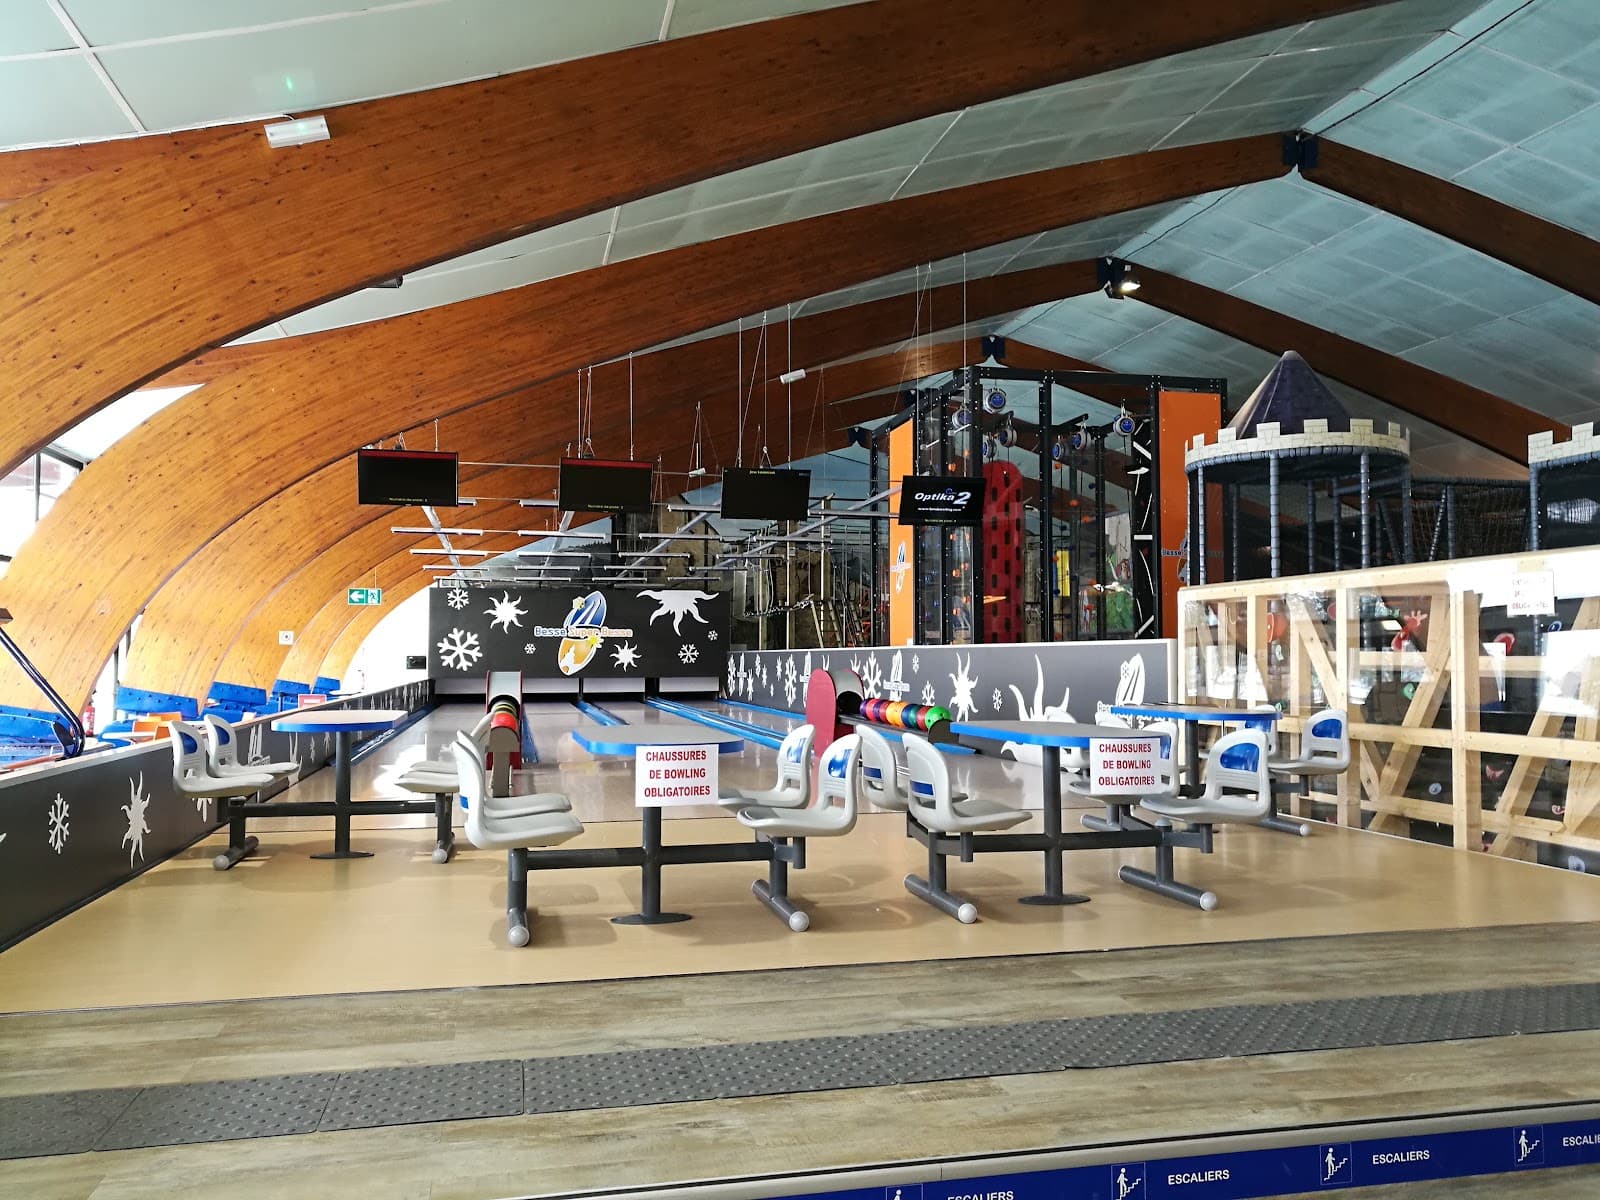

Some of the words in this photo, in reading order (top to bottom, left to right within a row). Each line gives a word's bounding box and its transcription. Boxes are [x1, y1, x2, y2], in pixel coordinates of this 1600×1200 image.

[914, 492, 955, 502] Optika
[952, 491, 972, 505] 2
[535, 626, 567, 637] Besse
[601, 626, 633, 637] Besse
[1099, 743, 1152, 753] CHAUSSURES
[646, 750, 707, 762] CHAUSSURES
[1103, 760, 1114, 769] DE
[1116, 759, 1152, 769] BOWLING
[649, 769, 662, 780] DE
[664, 768, 706, 779] BOWLING
[1098, 775, 1155, 786] OBLIGATOIRES
[644, 785, 711, 798] OBLIGATOIRES
[1372, 1150, 1431, 1165] ESCALIERS
[1167, 1169, 1230, 1186] ESCALIERS
